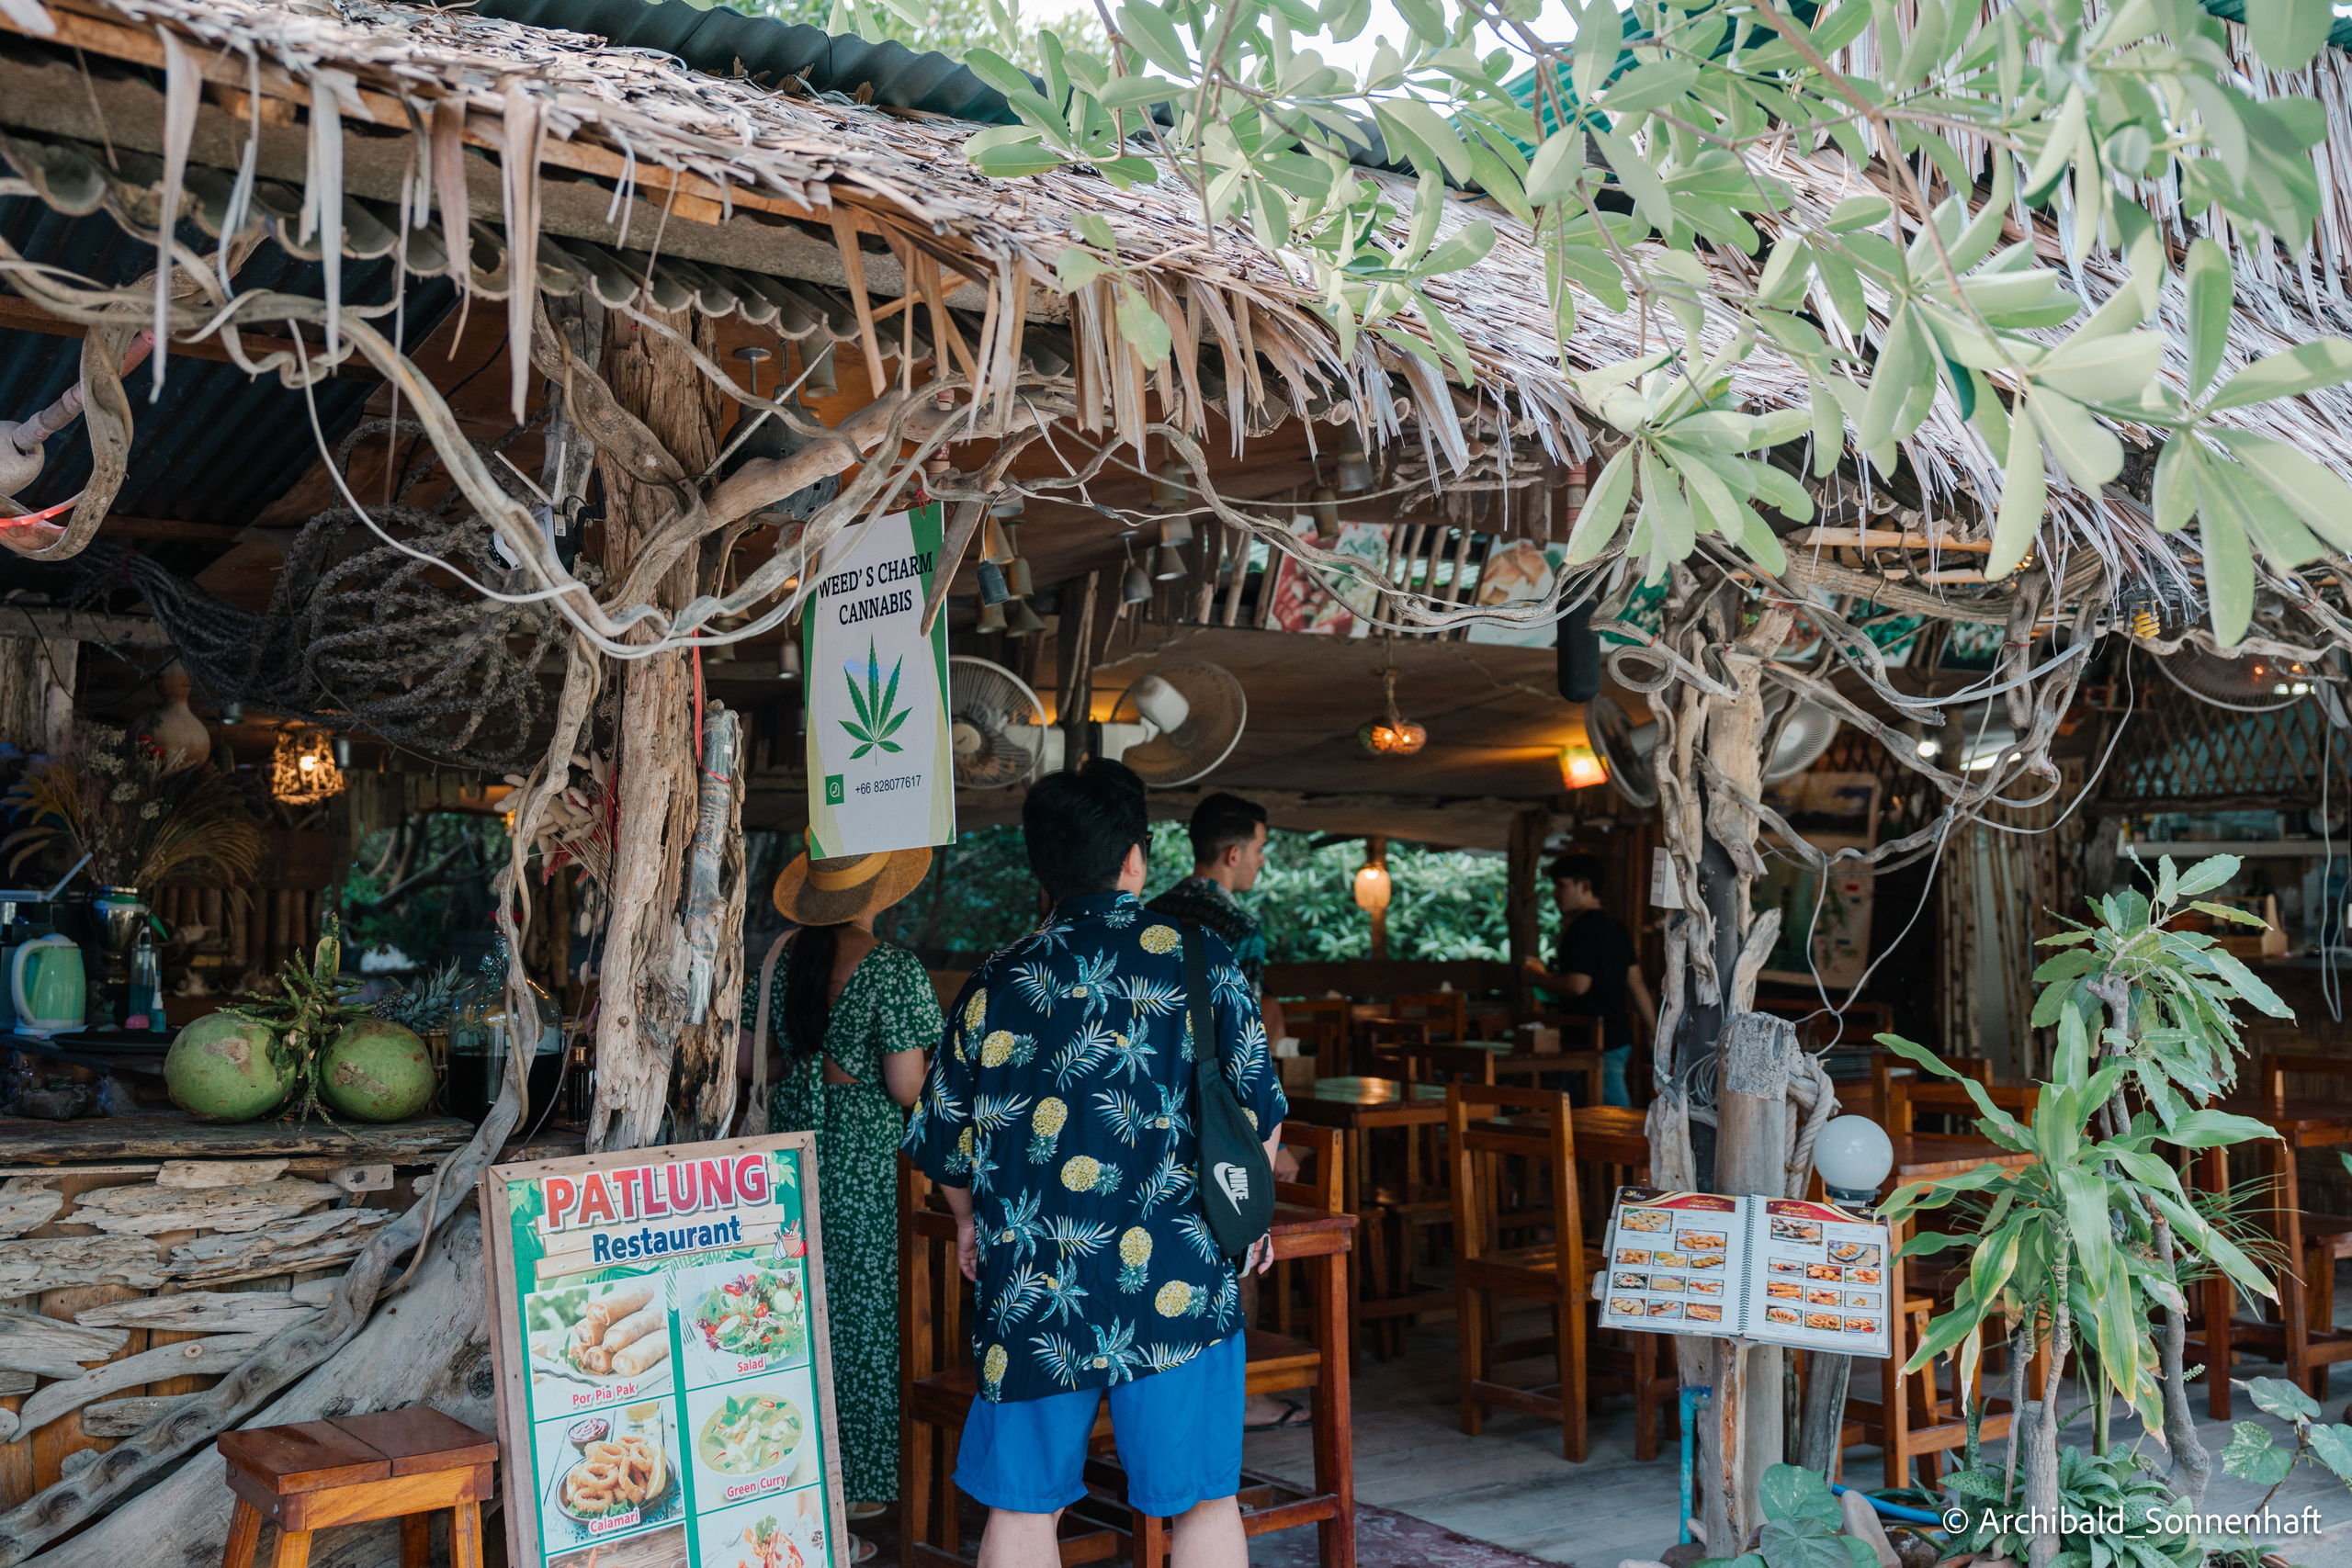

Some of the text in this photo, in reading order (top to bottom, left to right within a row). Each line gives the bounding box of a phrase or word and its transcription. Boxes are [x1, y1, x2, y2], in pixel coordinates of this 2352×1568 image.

[877, 551, 933, 584] CHARM
[839, 589, 912, 625] CANNABIS
[855, 774, 922, 795] +66 828077617
[544, 1153, 770, 1230] PATLUNG
[1227, 1167, 1250, 1201] NIKE
[592, 1214, 742, 1263] Restaurant
[737, 1356, 764, 1373] Salad
[572, 1382, 636, 1406] Por Pia Pak
[727, 1474, 786, 1498] Green Curry
[590, 1509, 639, 1533] Calamari
